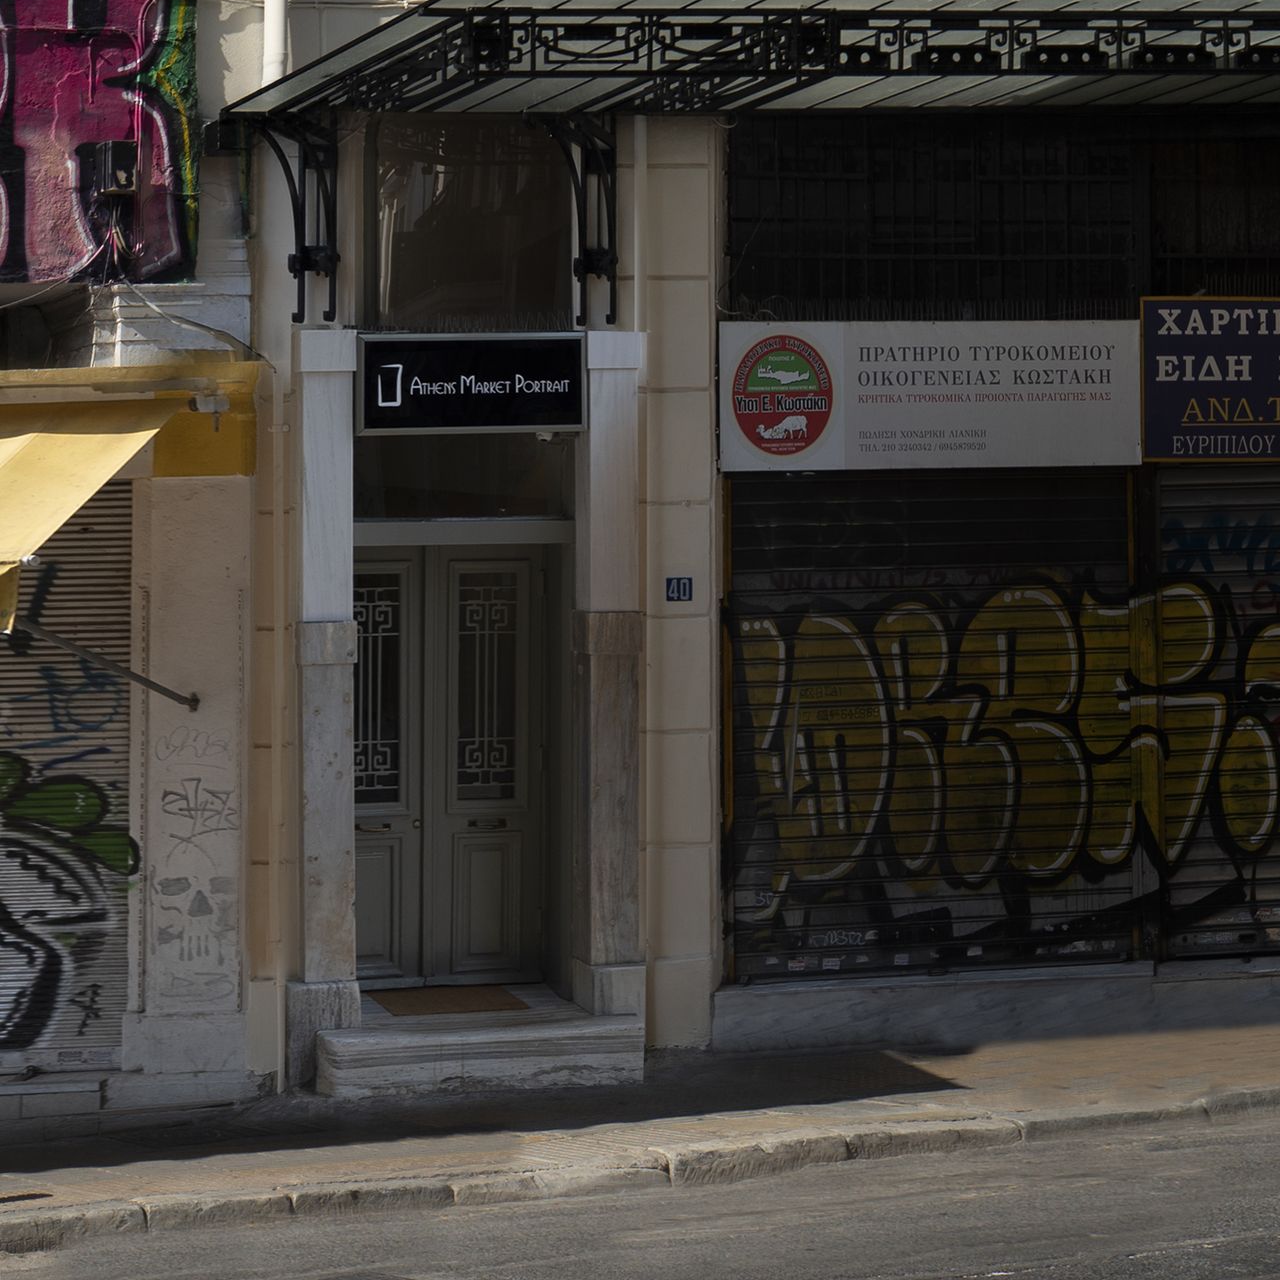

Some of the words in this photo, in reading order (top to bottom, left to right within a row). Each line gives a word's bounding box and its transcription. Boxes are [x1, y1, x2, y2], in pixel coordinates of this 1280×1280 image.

[859, 345, 960, 362] ΠΡΑΤΗΡΙΟ
[969, 344, 1116, 361] ΤΥΡΟΚΟΜΕΙΟΥ
[858, 369, 1001, 387] ΟΙΚΟΓΕΝΕΙΑΣ
[1013, 368, 1112, 385] ΚΩΣΤΑΚΗ
[1155, 355, 1253, 382] ΕΙΔΗ
[410, 376, 457, 396] ATHENS
[460, 375, 511, 395] MARKET
[515, 374, 570, 394] PORTRAIT
[858, 394, 903, 404] ΚΡΗΤΙΚΑ
[906, 393, 971, 403] ΤΥΡΟΚΟΜΙΚΑ
[975, 392, 1023, 402] ΠΡΟΙΟΝΤΑ
[1027, 392, 1087, 402] ΠΑΡΑΓΩΓΗΣ
[1089, 392, 1112, 401] ΜΑΣ
[858, 430, 897, 440] ΠΩΛΗΣΗ
[900, 430, 945, 439] ΧΟΝΔΡΙΚΗ
[948, 429, 986, 438] ΛΙΑΝΙΚΗ
[859, 443, 880, 452] ΤΗΛ.
[882, 443, 896, 452] 210
[1172, 434, 1276, 455] ΕΥΡΙΠΙΔΟΥ
[668, 578, 690, 600] 40
